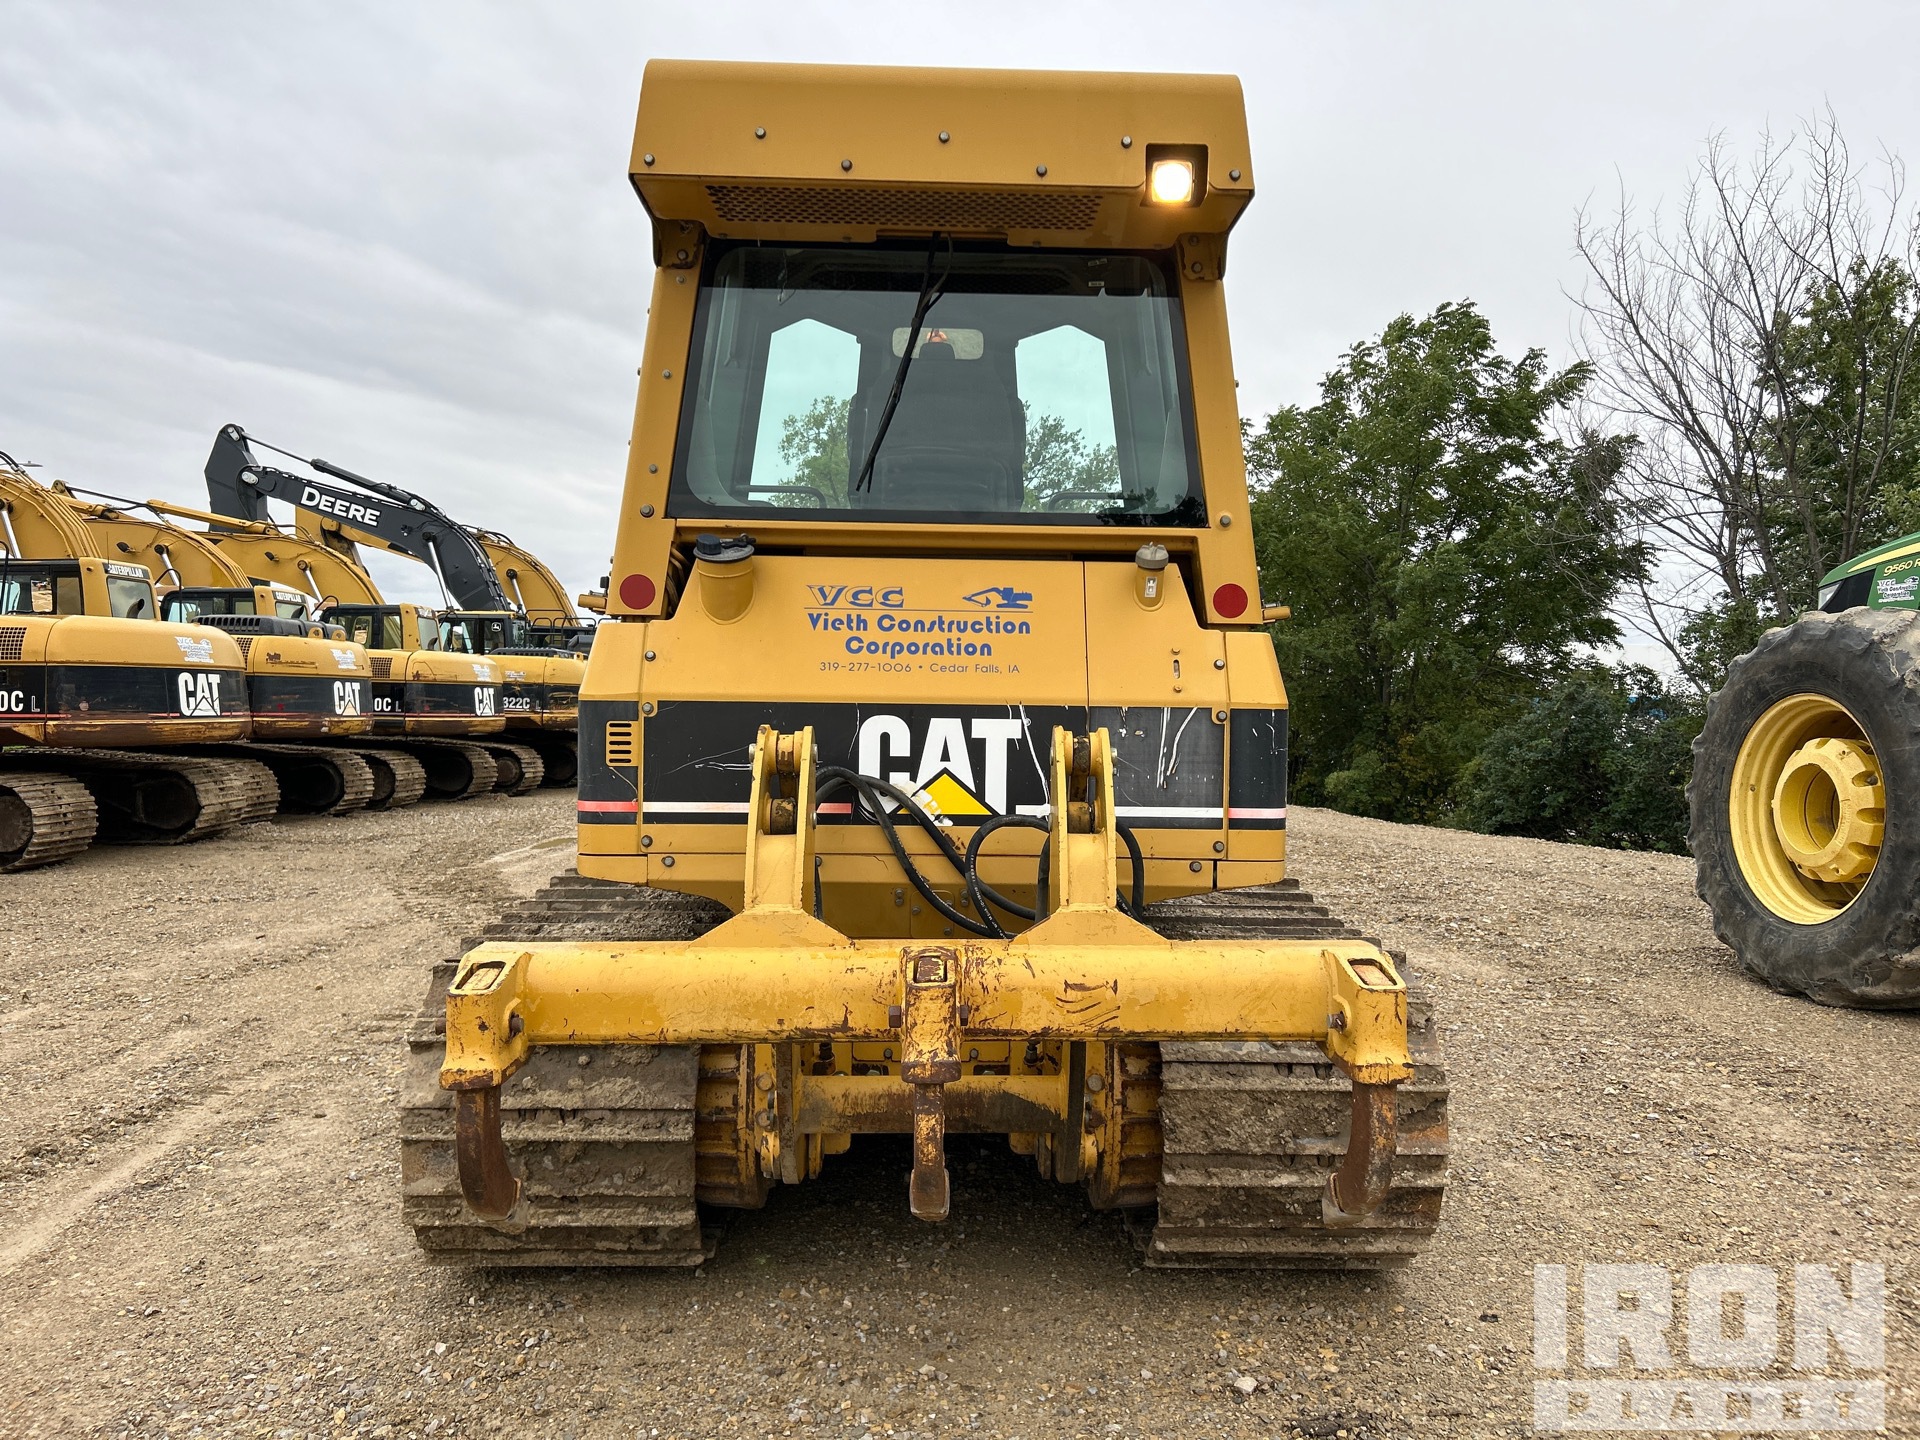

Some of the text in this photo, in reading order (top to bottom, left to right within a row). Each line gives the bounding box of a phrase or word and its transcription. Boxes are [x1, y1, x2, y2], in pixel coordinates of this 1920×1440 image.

[301, 486, 380, 526] DEERE
[1884, 561, 1912, 576] 9560
[806, 585, 904, 608] VCC
[808, 612, 1031, 634] Vieth Construction
[845, 636, 993, 660] Corporation
[820, 662, 1020, 674] 319-277-1006 Cedar Falls, IA
[31, 695, 41, 712] L
[178, 672, 220, 716] CAT
[333, 681, 360, 716] CAT
[474, 687, 495, 716] CAT
[503, 697, 530, 709] 322C
[395, 700, 402, 712] L
[859, 715, 1022, 816] CAT
